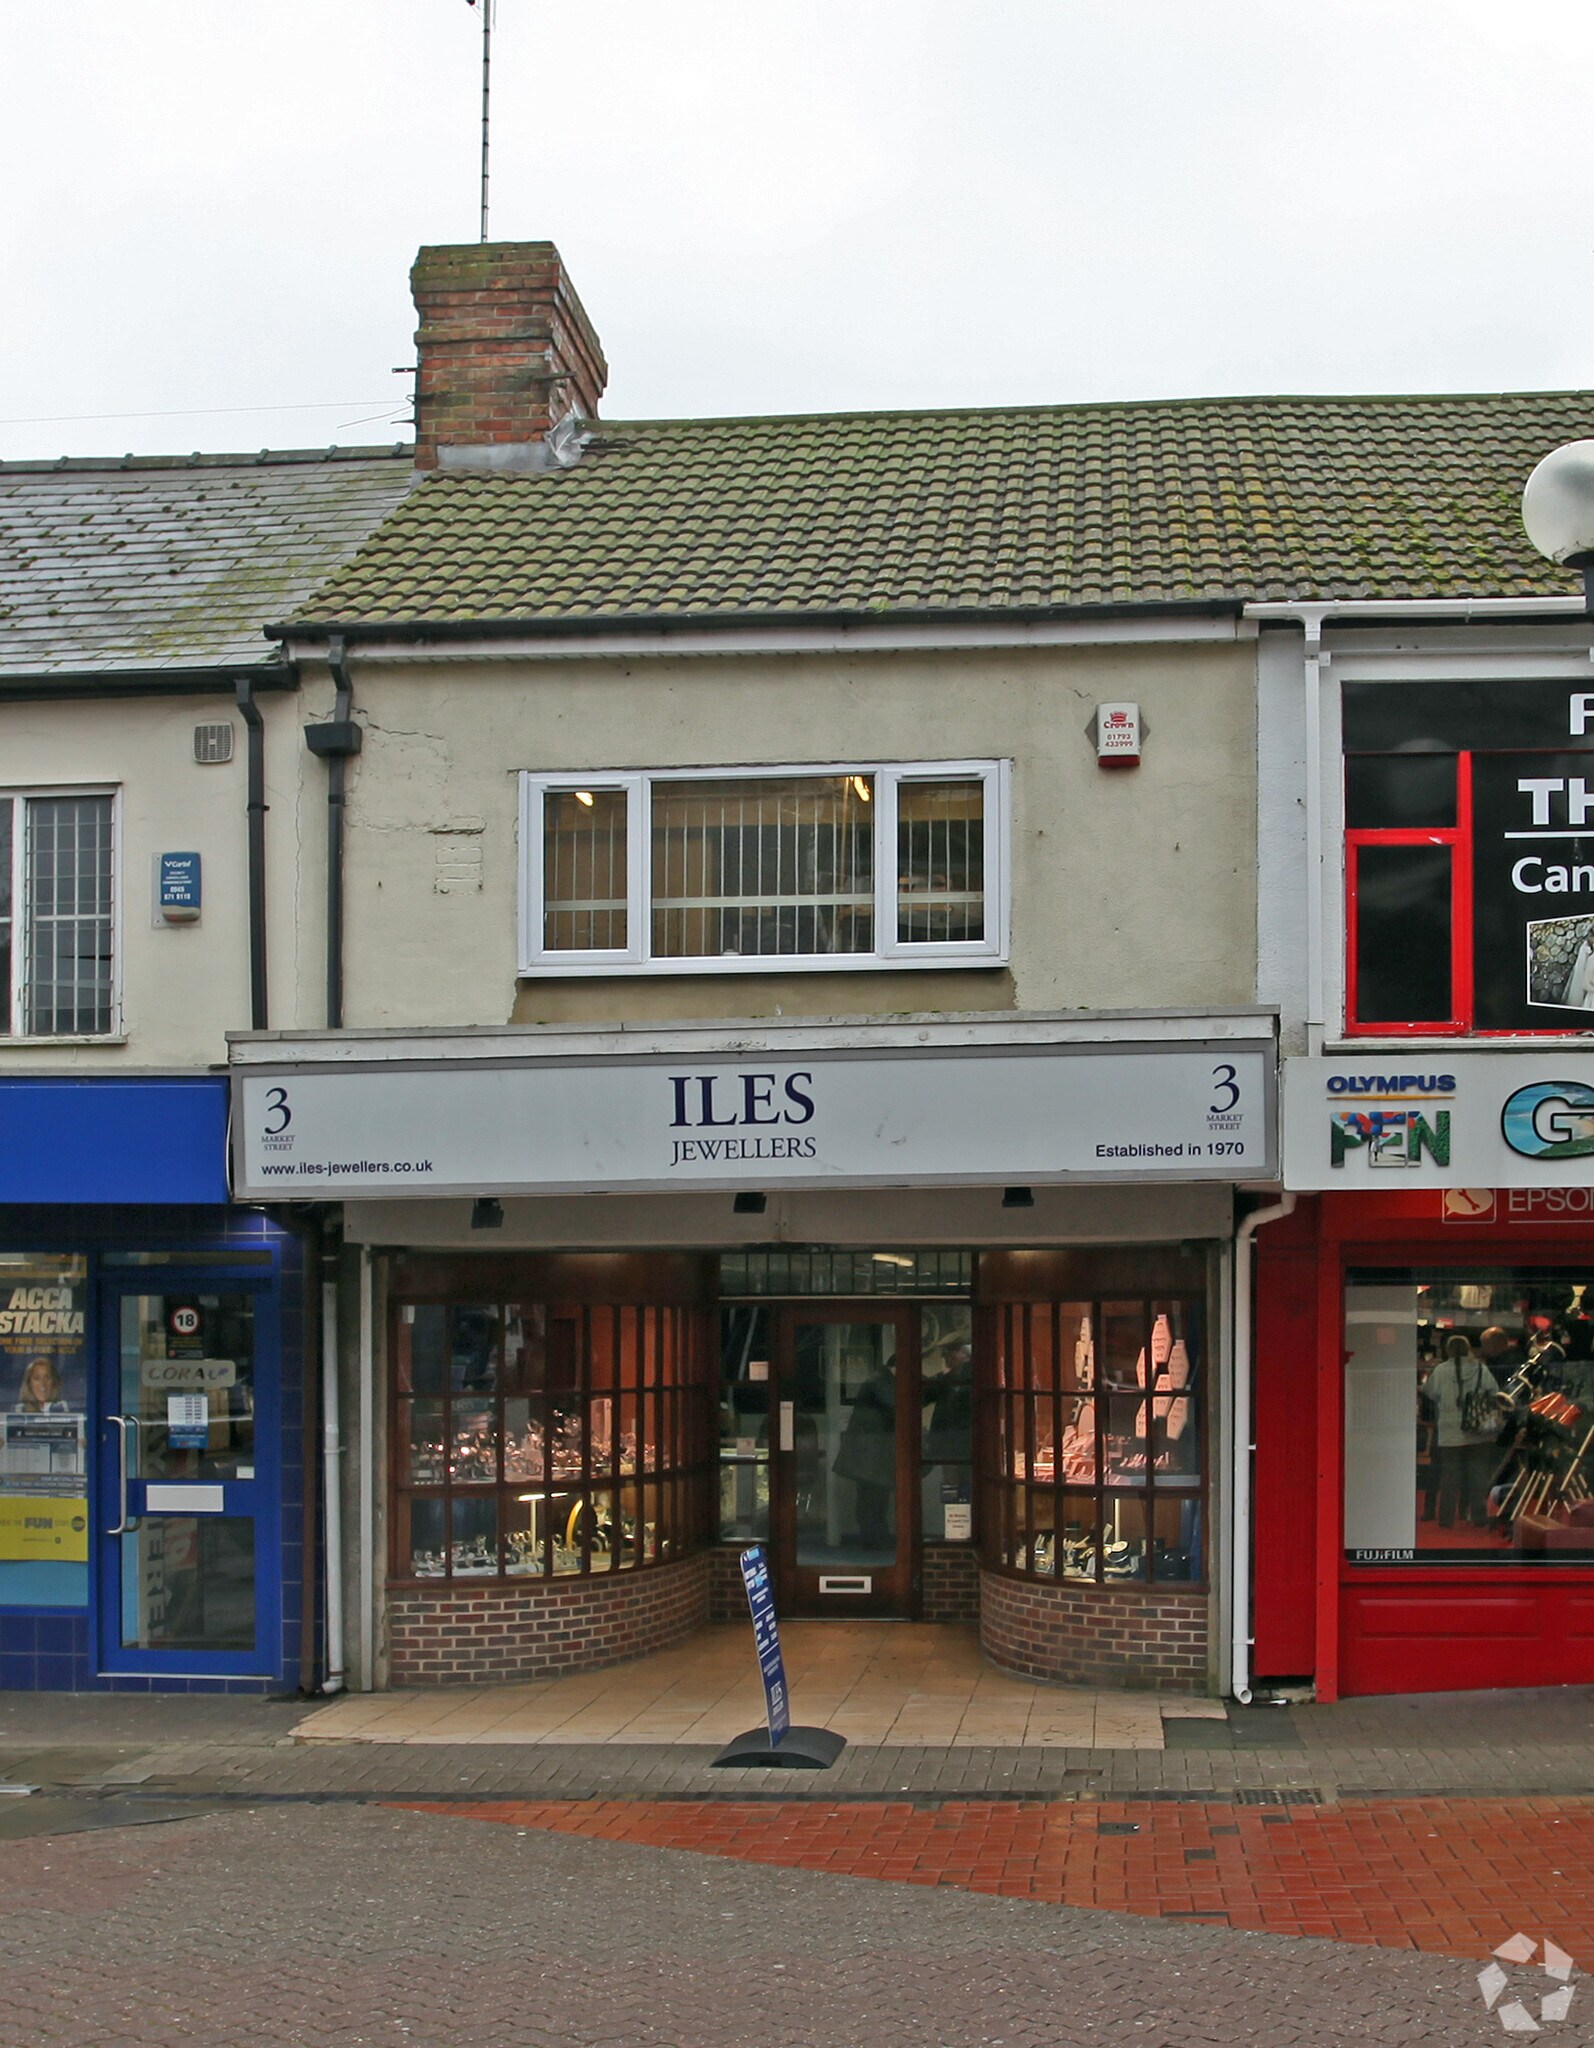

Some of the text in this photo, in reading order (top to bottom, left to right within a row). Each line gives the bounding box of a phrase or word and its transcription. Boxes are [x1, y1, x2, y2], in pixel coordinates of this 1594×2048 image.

[1103, 721, 1134, 729] Crown
[1209, 1064, 1241, 1113] 3
[1327, 1075, 1456, 1094] OLYMPUS
[668, 1072, 815, 1127] ILES
[264, 1086, 292, 1135] 3
[1206, 1114, 1245, 1122] MARKET
[1208, 1122, 1242, 1131] STREET
[261, 1135, 296, 1143] MARKET
[263, 1143, 294, 1151] STREET
[1331, 1111, 1450, 1168] PEN
[670, 1137, 817, 1166] JEWELLERS
[1095, 1142, 1245, 1157] Established in 1970
[261, 1160, 433, 1176] www.iles-jewellers.co.uk
[1508, 1188, 1594, 1211] EPSO
[8, 1287, 73, 1310] ACCA
[0, 1311, 84, 1334] STACKA
[176, 1313, 195, 1327] 18
[149, 1366, 219, 1381] CORAL
